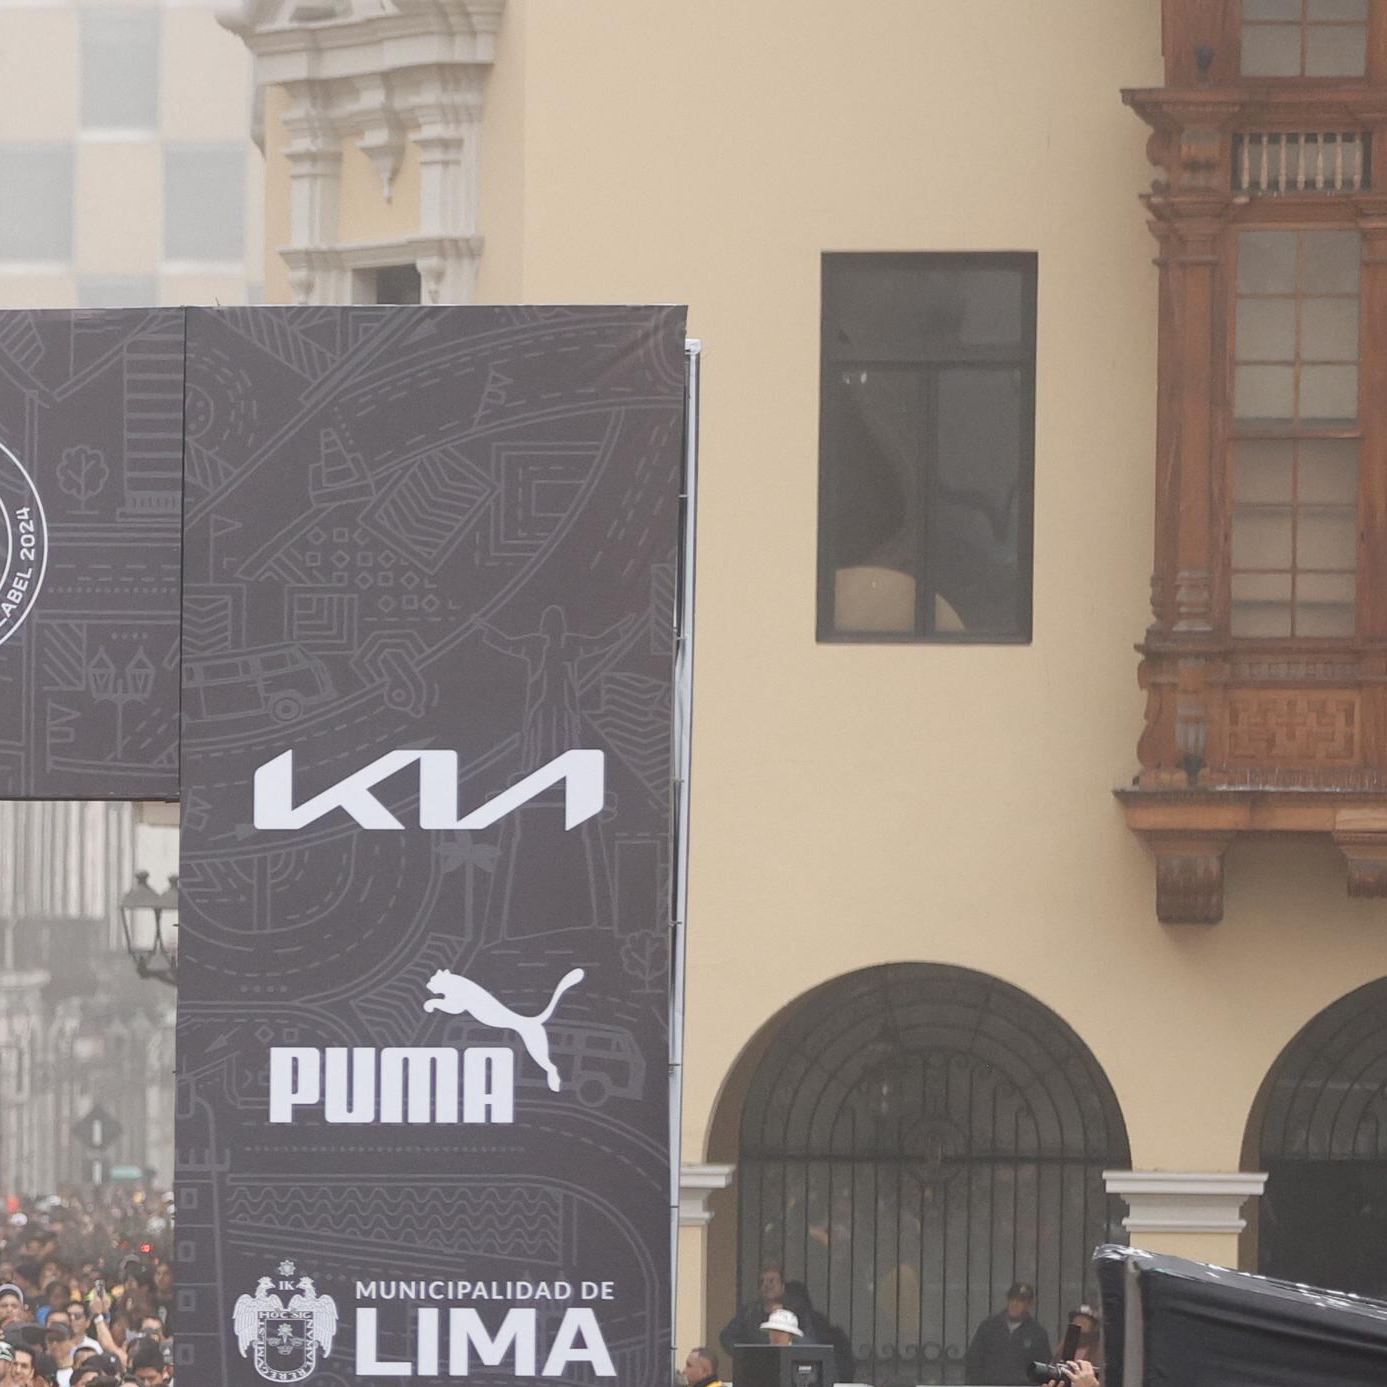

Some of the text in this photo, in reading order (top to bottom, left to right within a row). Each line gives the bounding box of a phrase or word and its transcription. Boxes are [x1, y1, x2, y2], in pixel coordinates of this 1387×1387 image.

[15, 506, 36, 561] 2024
[253, 749, 604, 831] KIA
[269, 1047, 515, 1124] PUMA
[278, 1281, 296, 1290] IK
[356, 1280, 615, 1300] MUNICIPALIDAD DE
[355, 1306, 617, 1377] LIMA
